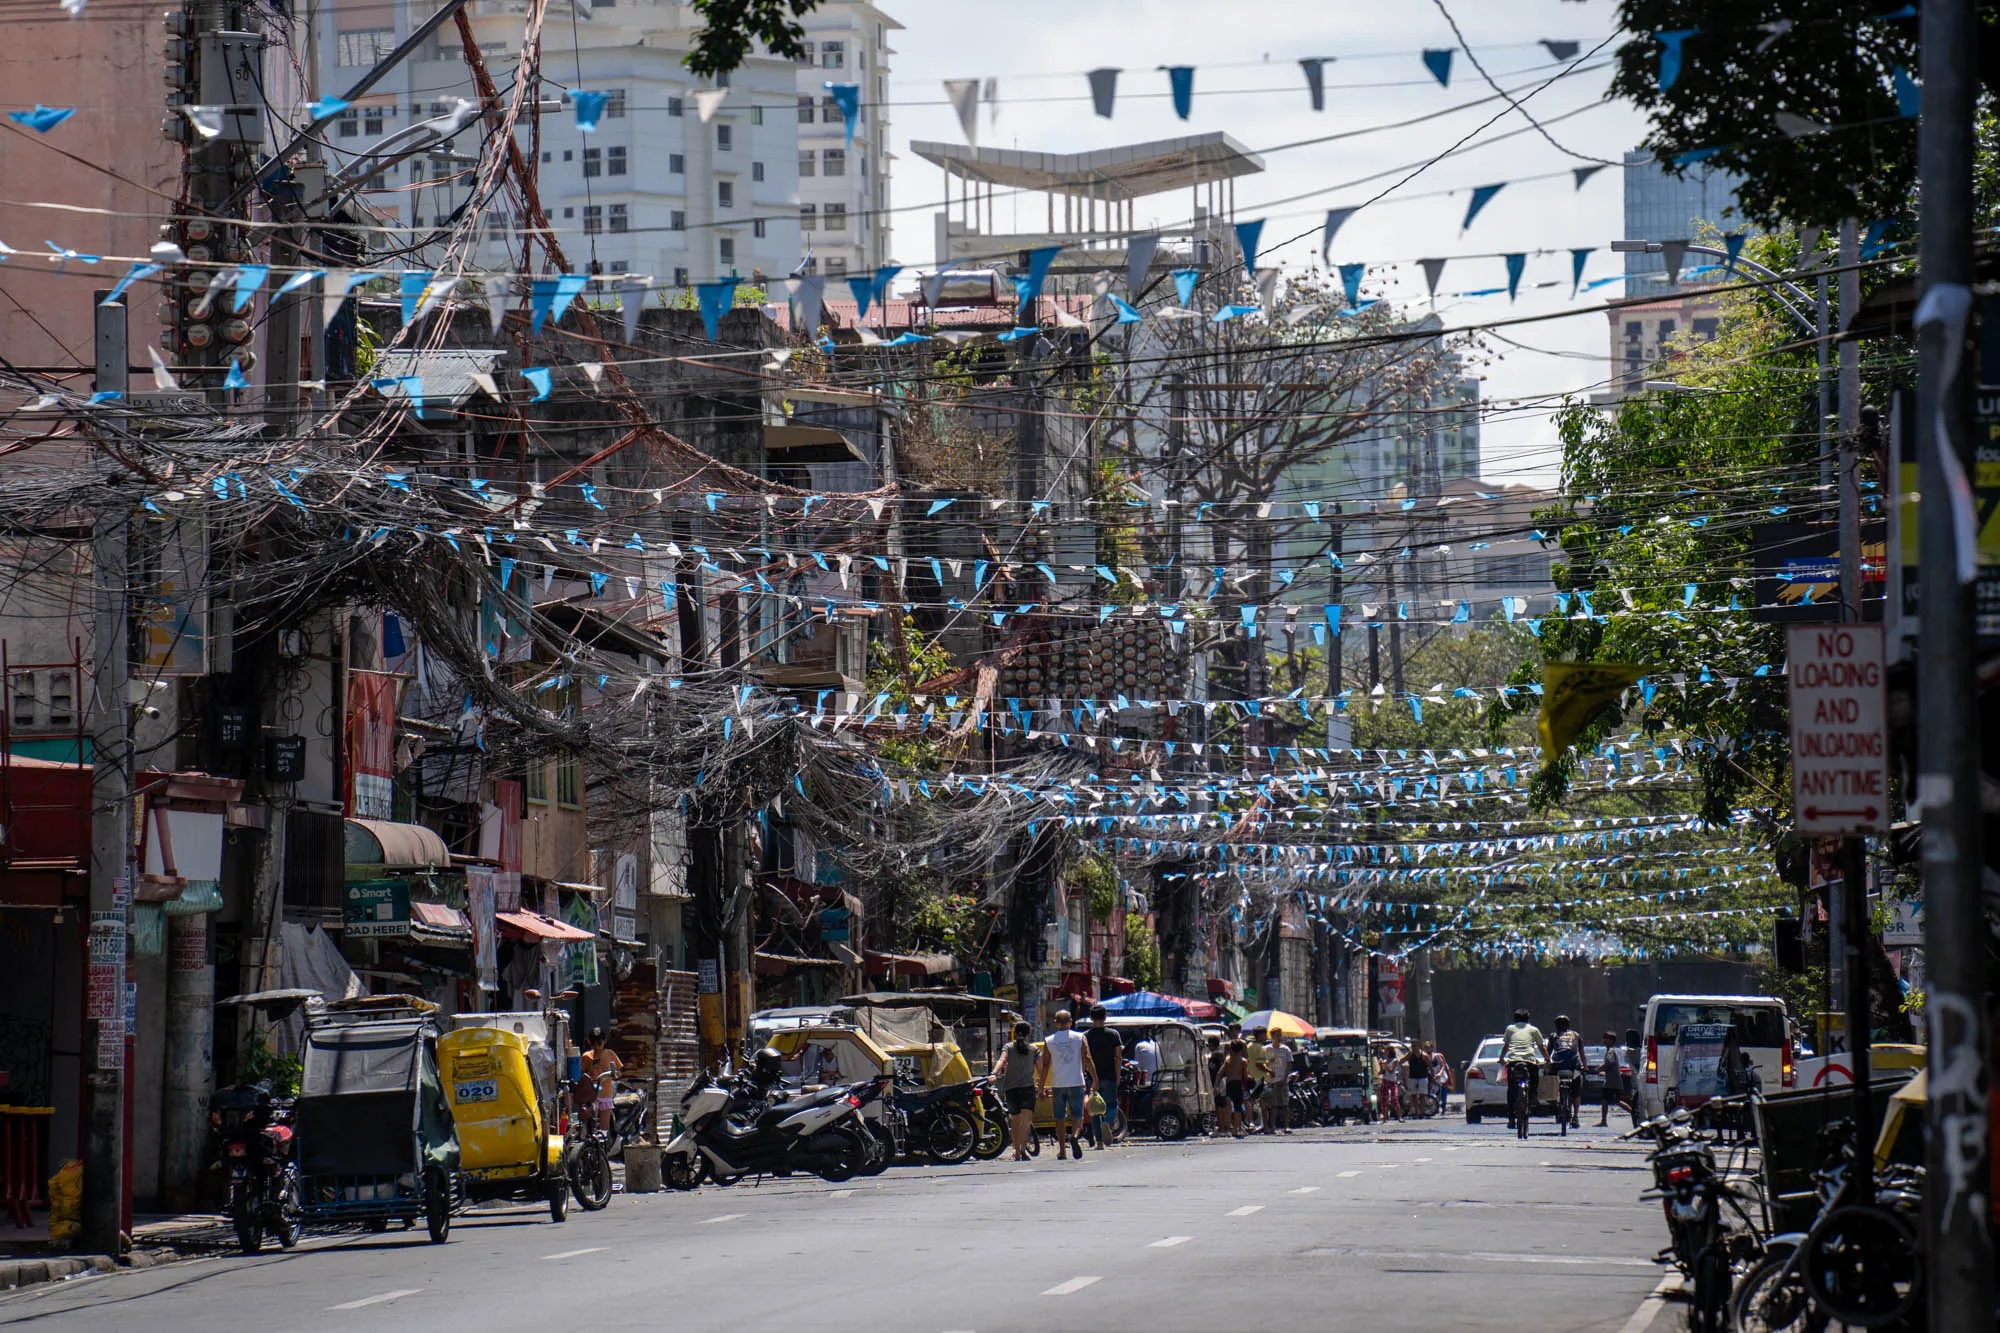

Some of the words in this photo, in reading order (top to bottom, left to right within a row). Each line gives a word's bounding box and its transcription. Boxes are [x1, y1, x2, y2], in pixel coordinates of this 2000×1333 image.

[1817, 632, 1853, 657] NO
[1794, 662, 1878, 688] LOADING
[1815, 698, 1859, 723] AND
[1798, 730, 1882, 757] UNLOADING
[1800, 769, 1882, 795] ANYTIME
[361, 887, 392, 898] Smart
[373, 925, 407, 934] HERE!
[459, 1086, 493, 1098] 020
